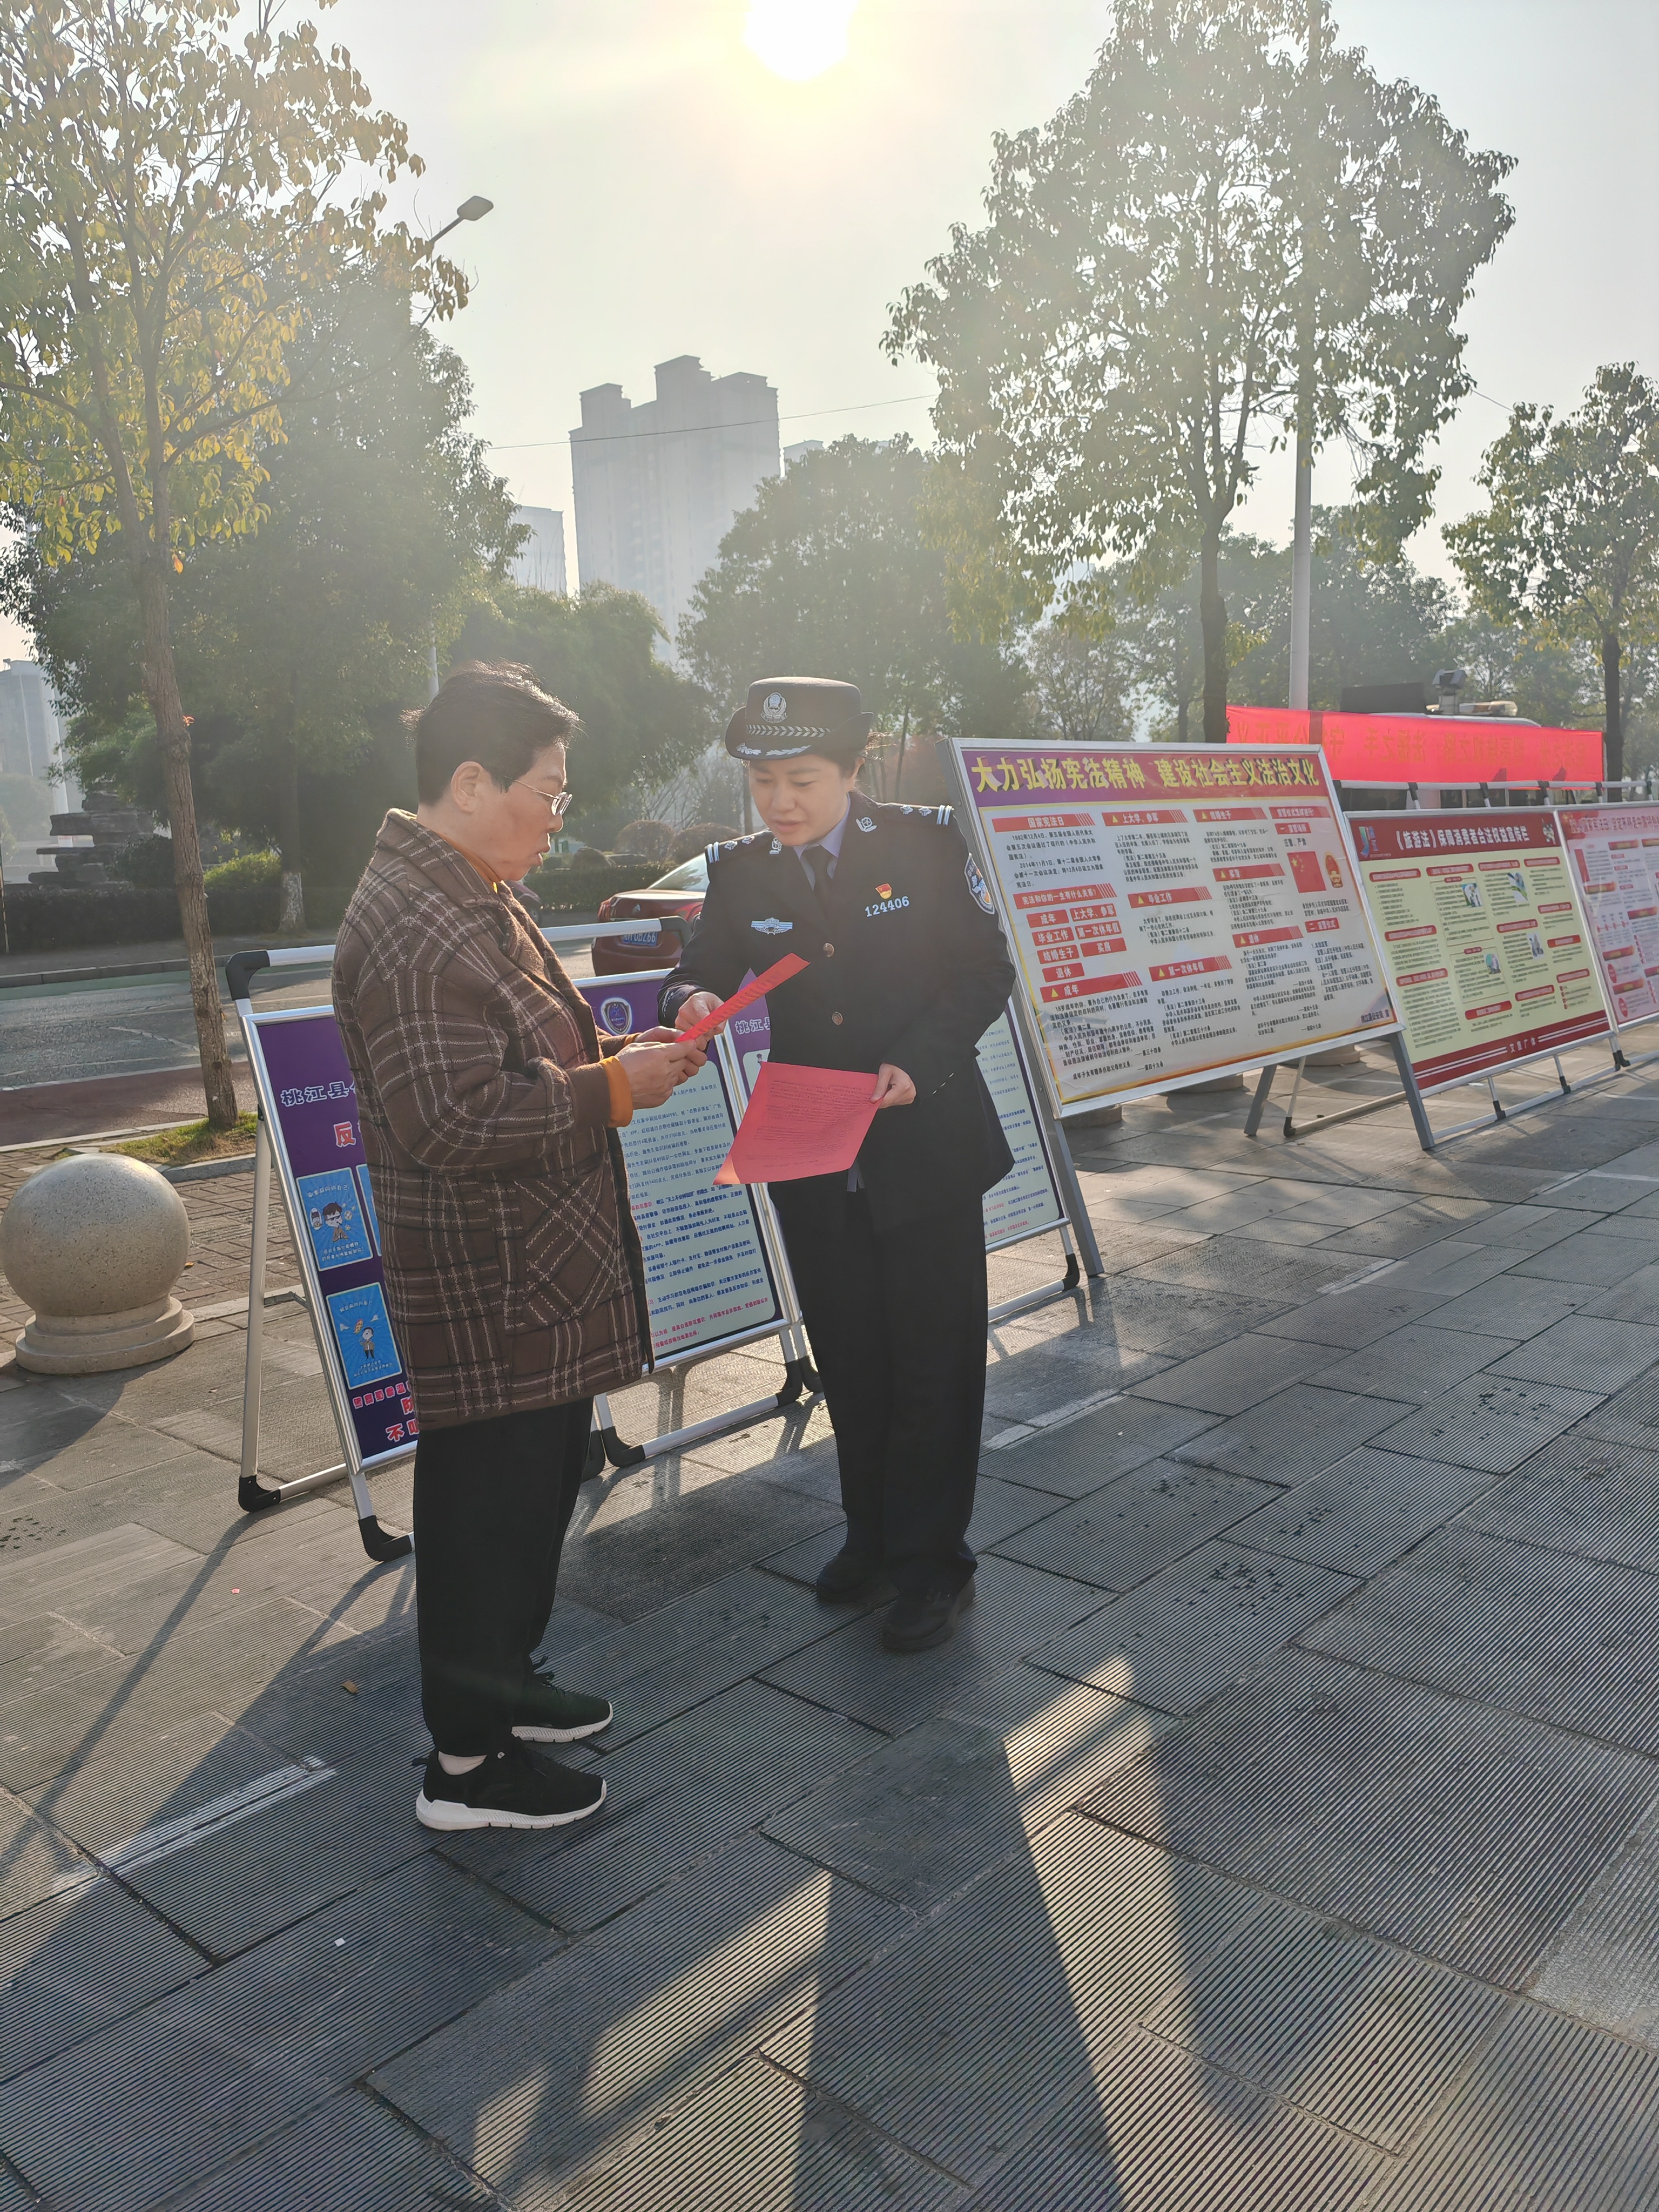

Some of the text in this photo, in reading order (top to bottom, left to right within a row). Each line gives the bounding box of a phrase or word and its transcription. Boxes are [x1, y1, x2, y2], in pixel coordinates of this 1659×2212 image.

[972, 756, 1320, 793] 大力弘扬宪法精神 建设社会主义法治文化
[1027, 816, 1064, 828] 国家宪法日
[1121, 813, 1159, 824] 上大学、参军
[865, 895, 910, 918] 124406
[1071, 905, 1116, 920] 上大学、参军
[1038, 912, 1057, 923] 成年
[1036, 929, 1069, 944] 毕业工作
[1076, 922, 1120, 937] 第一次休年假
[1041, 946, 1075, 962] 结婚生子
[1096, 941, 1111, 953] 买房
[1054, 966, 1072, 979] 退休
[1062, 983, 1080, 996] 成年
[333, 1120, 361, 1148] 反
[352, 1380, 412, 1410] 警察蜀黍温
